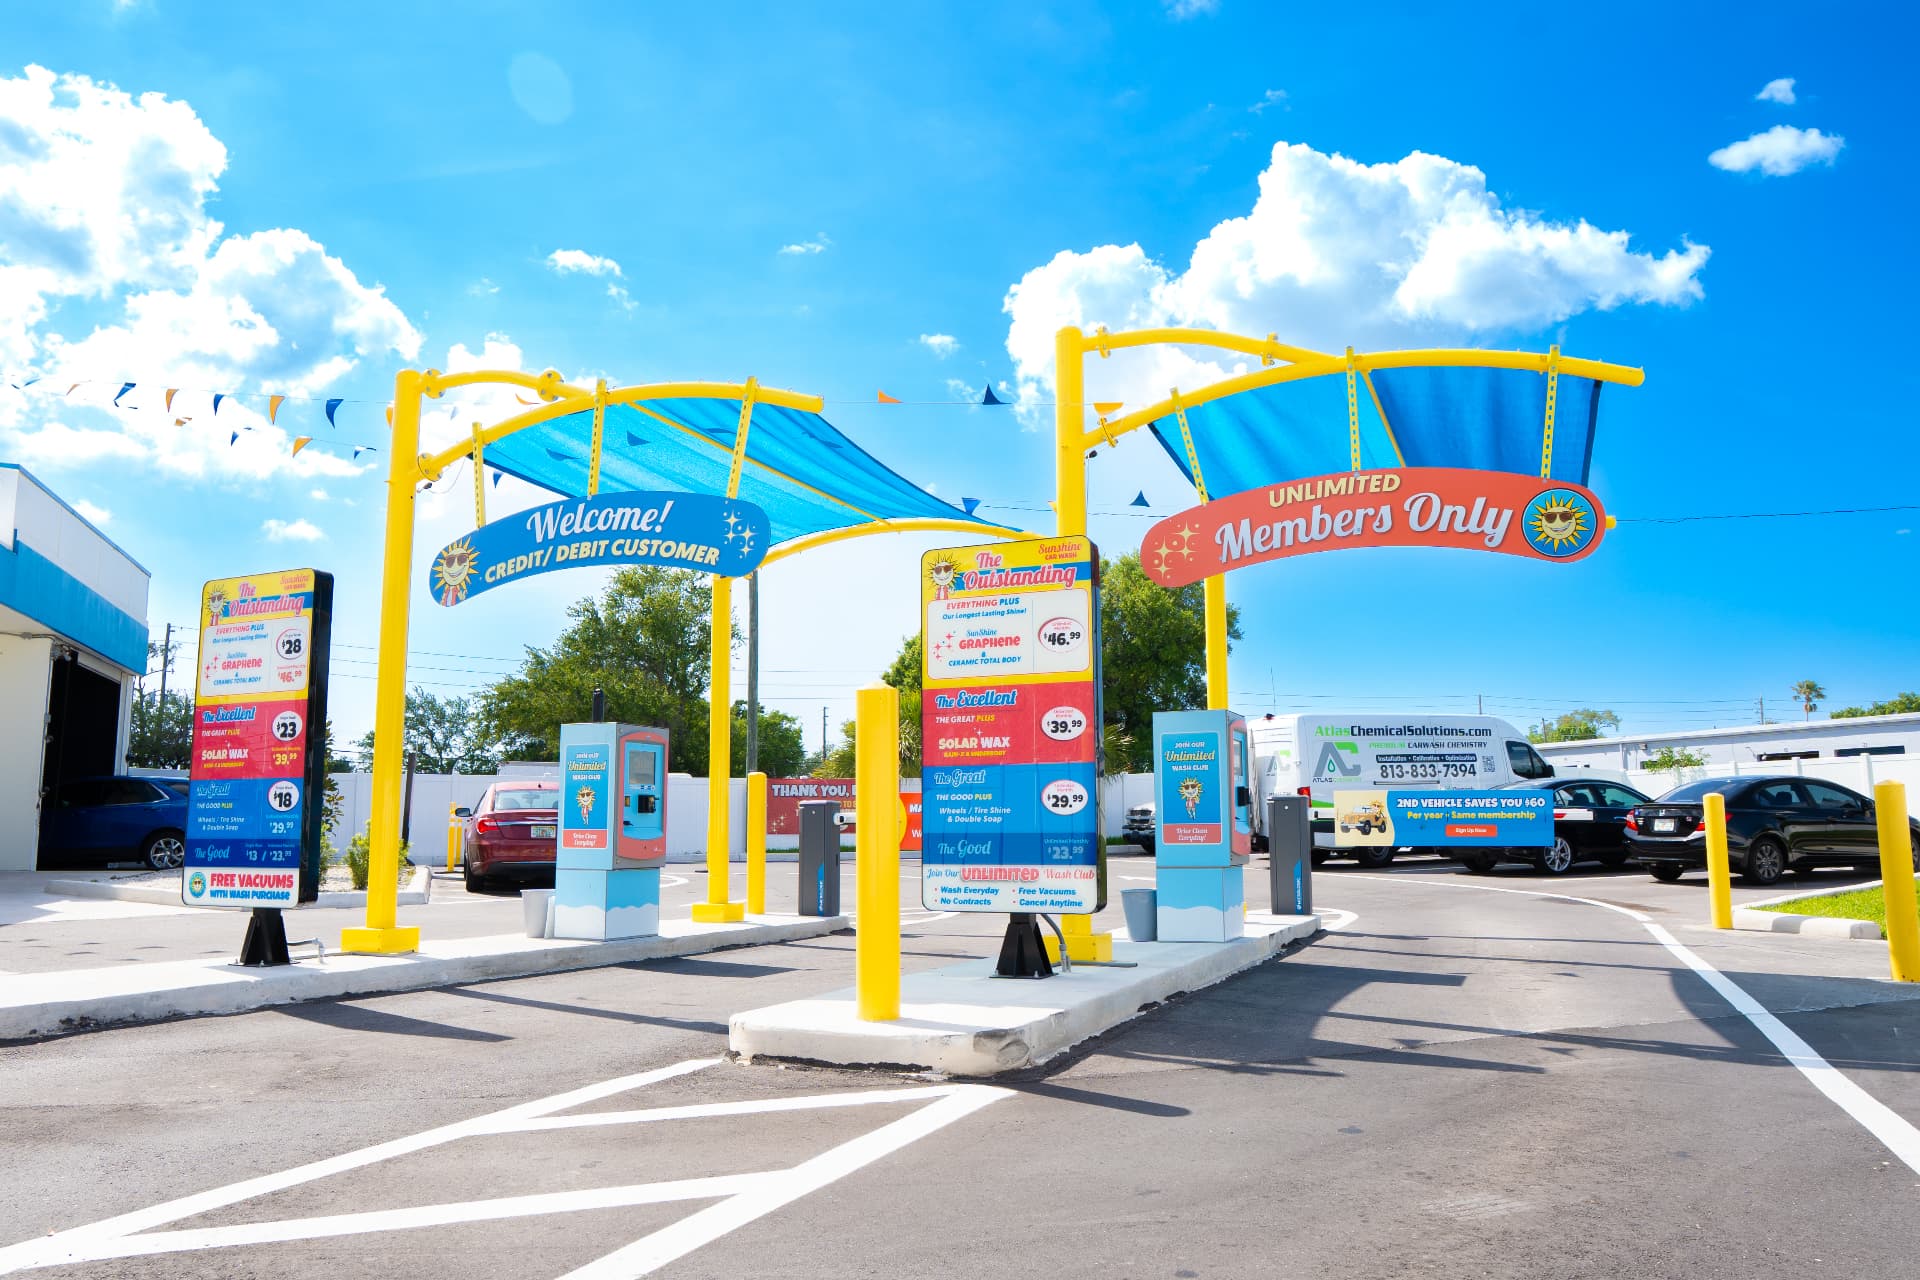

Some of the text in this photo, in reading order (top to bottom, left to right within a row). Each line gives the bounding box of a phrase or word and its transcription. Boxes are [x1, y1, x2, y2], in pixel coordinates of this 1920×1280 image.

[1269, 474, 1401, 508] UNLIMITED
[526, 501, 674, 543] Welcome!
[1214, 492, 1513, 563] Members Only
[1039, 543, 1082, 554] Sunshine
[485, 539, 719, 583] CREDIT/ DEBIT CUSTOMER
[976, 552, 1001, 569] The
[964, 566, 1076, 590] Outstanding
[239, 582, 256, 597] The
[230, 595, 304, 616] Outstanding
[946, 598, 1020, 610] EVERYTHING PLUS
[955, 612, 981, 620] Longest
[982, 610, 1005, 618] Lasting
[1044, 632, 1081, 646] $46.99
[282, 639, 301, 654] $28
[1002, 656, 1021, 664] BODY
[936, 690, 1017, 708] The Excellent
[203, 706, 256, 723] The Excellent
[277, 722, 297, 738] $23
[1047, 720, 1082, 733] $39.99
[1315, 726, 1492, 737] AtlasChemicalSolutions.com
[939, 737, 1010, 750] SOLAR WAX
[202, 748, 249, 760] SOLAR WAX
[1166, 750, 1215, 762] Unlimited
[568, 761, 606, 771] Unlimited
[1381, 764, 1477, 779] 813-833-7394
[935, 769, 985, 787] The Great
[772, 784, 819, 798] THANK
[821, 784, 850, 798] YOU,
[274, 791, 292, 808] $18
[1048, 795, 1083, 808] $29.99
[1397, 798, 1546, 808] 2ND VEHICLE SAVES YOU $60
[983, 816, 1002, 824] Soap
[1424, 813, 1444, 821] year
[1452, 811, 1476, 819] Same
[1478, 811, 1536, 821] membership
[195, 845, 230, 861] The Good
[938, 839, 992, 858] The Good
[210, 873, 294, 888] FREE VACUUMS
[927, 869, 943, 879] Join
[945, 869, 958, 877] Our
[1044, 870, 1071, 879] Wash
[1074, 870, 1095, 879] Club
[210, 890, 228, 899] WITH
[229, 890, 251, 899] WASH
[940, 886, 1000, 895] Wash Everyday
